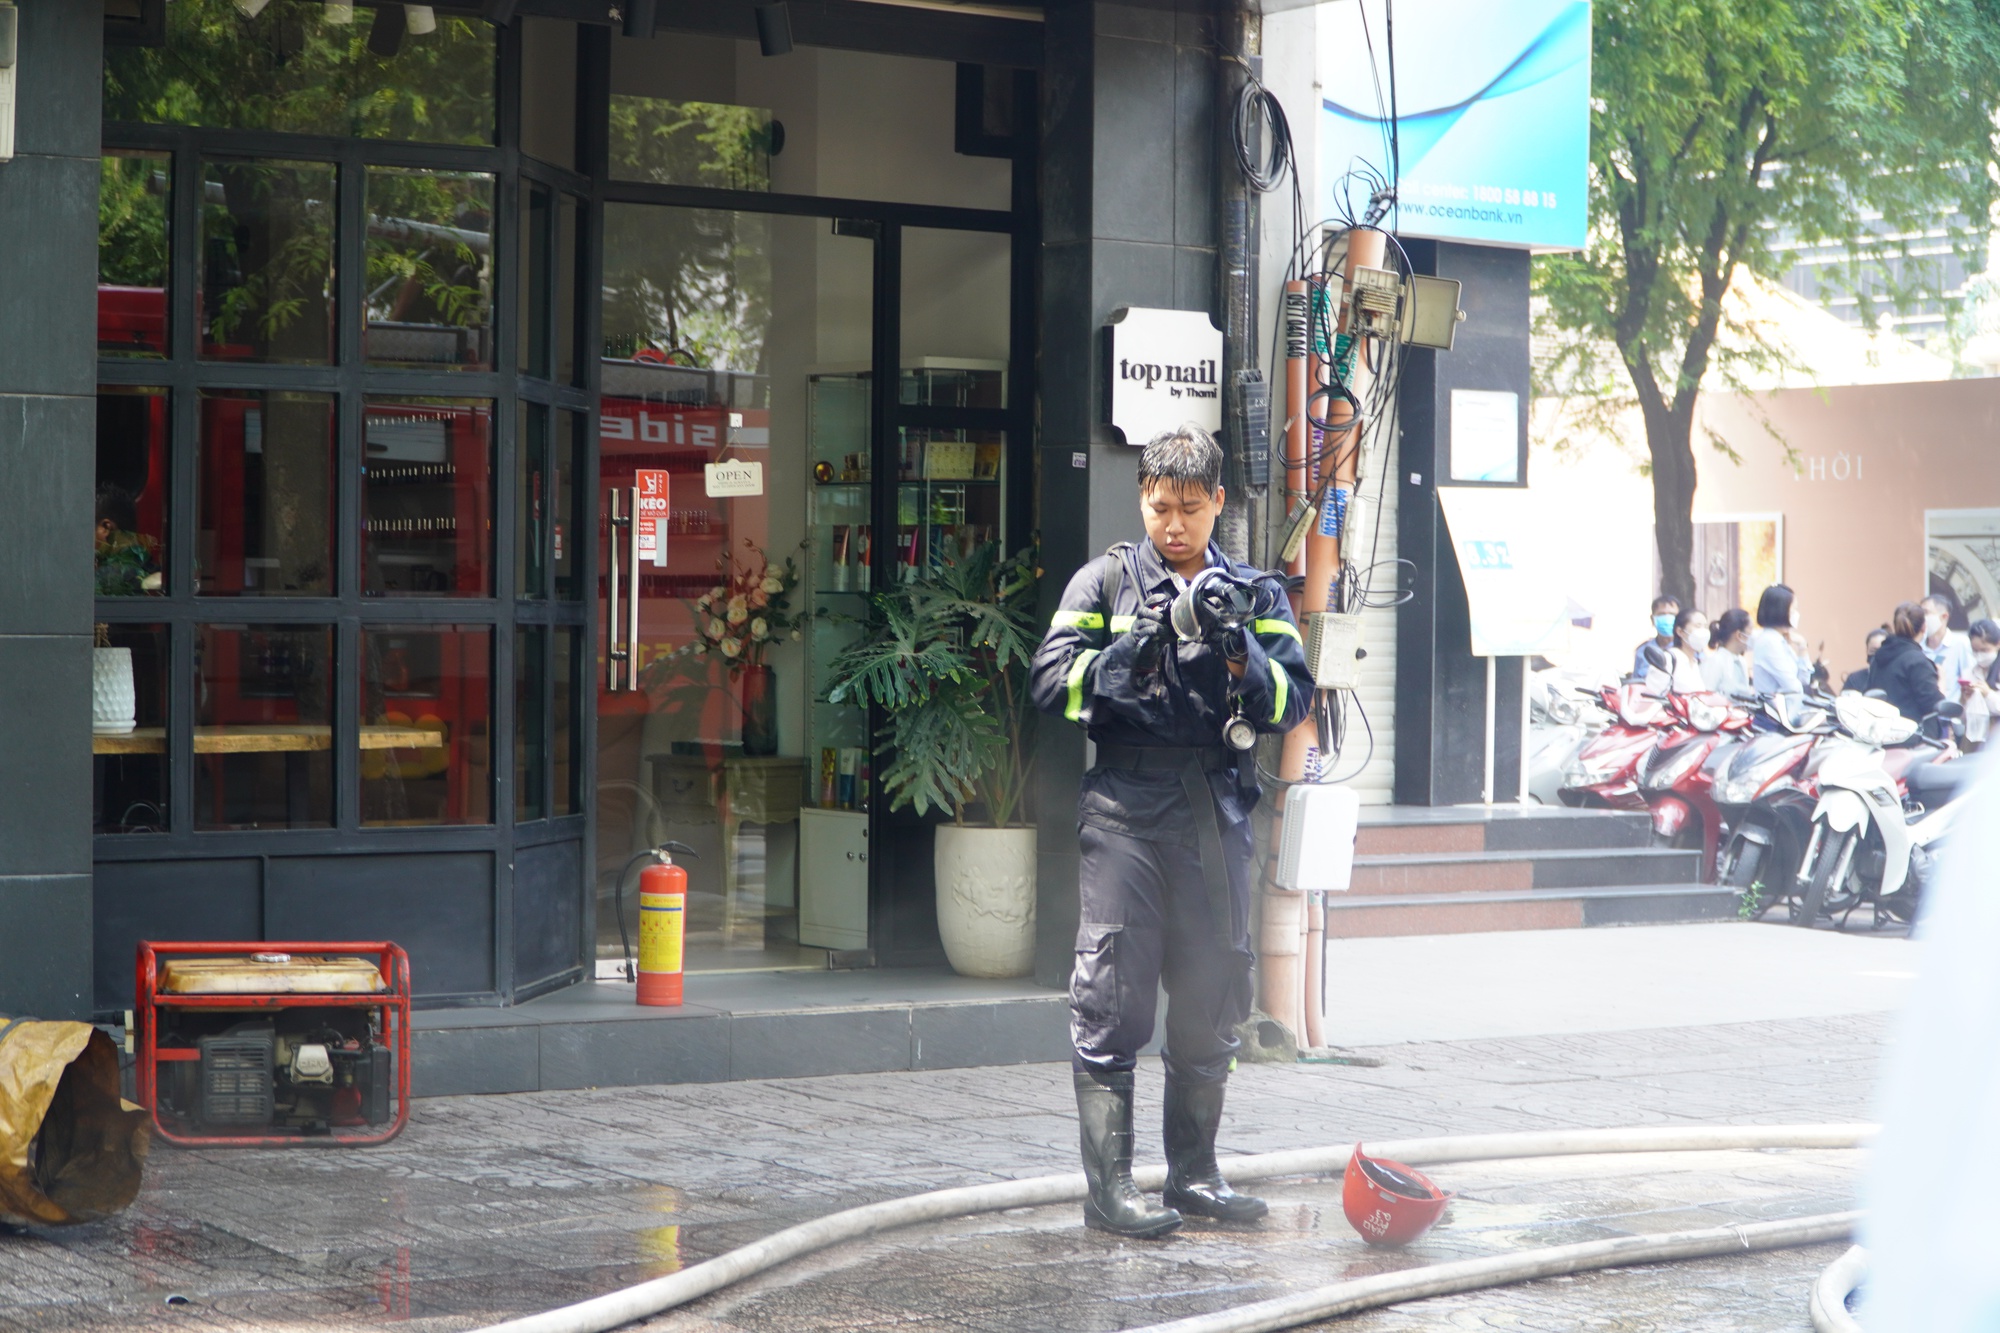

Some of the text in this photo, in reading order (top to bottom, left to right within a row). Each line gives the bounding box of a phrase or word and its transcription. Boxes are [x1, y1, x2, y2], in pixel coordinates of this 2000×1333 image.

[1473, 184, 1502, 204] 1800
[1543, 192, 1557, 209] 15
[1119, 358, 1217, 389] top nail
[1171, 386, 1183, 399] by
[715, 470, 752, 481] OPEN
[1792, 450, 1863, 481] HỜI
